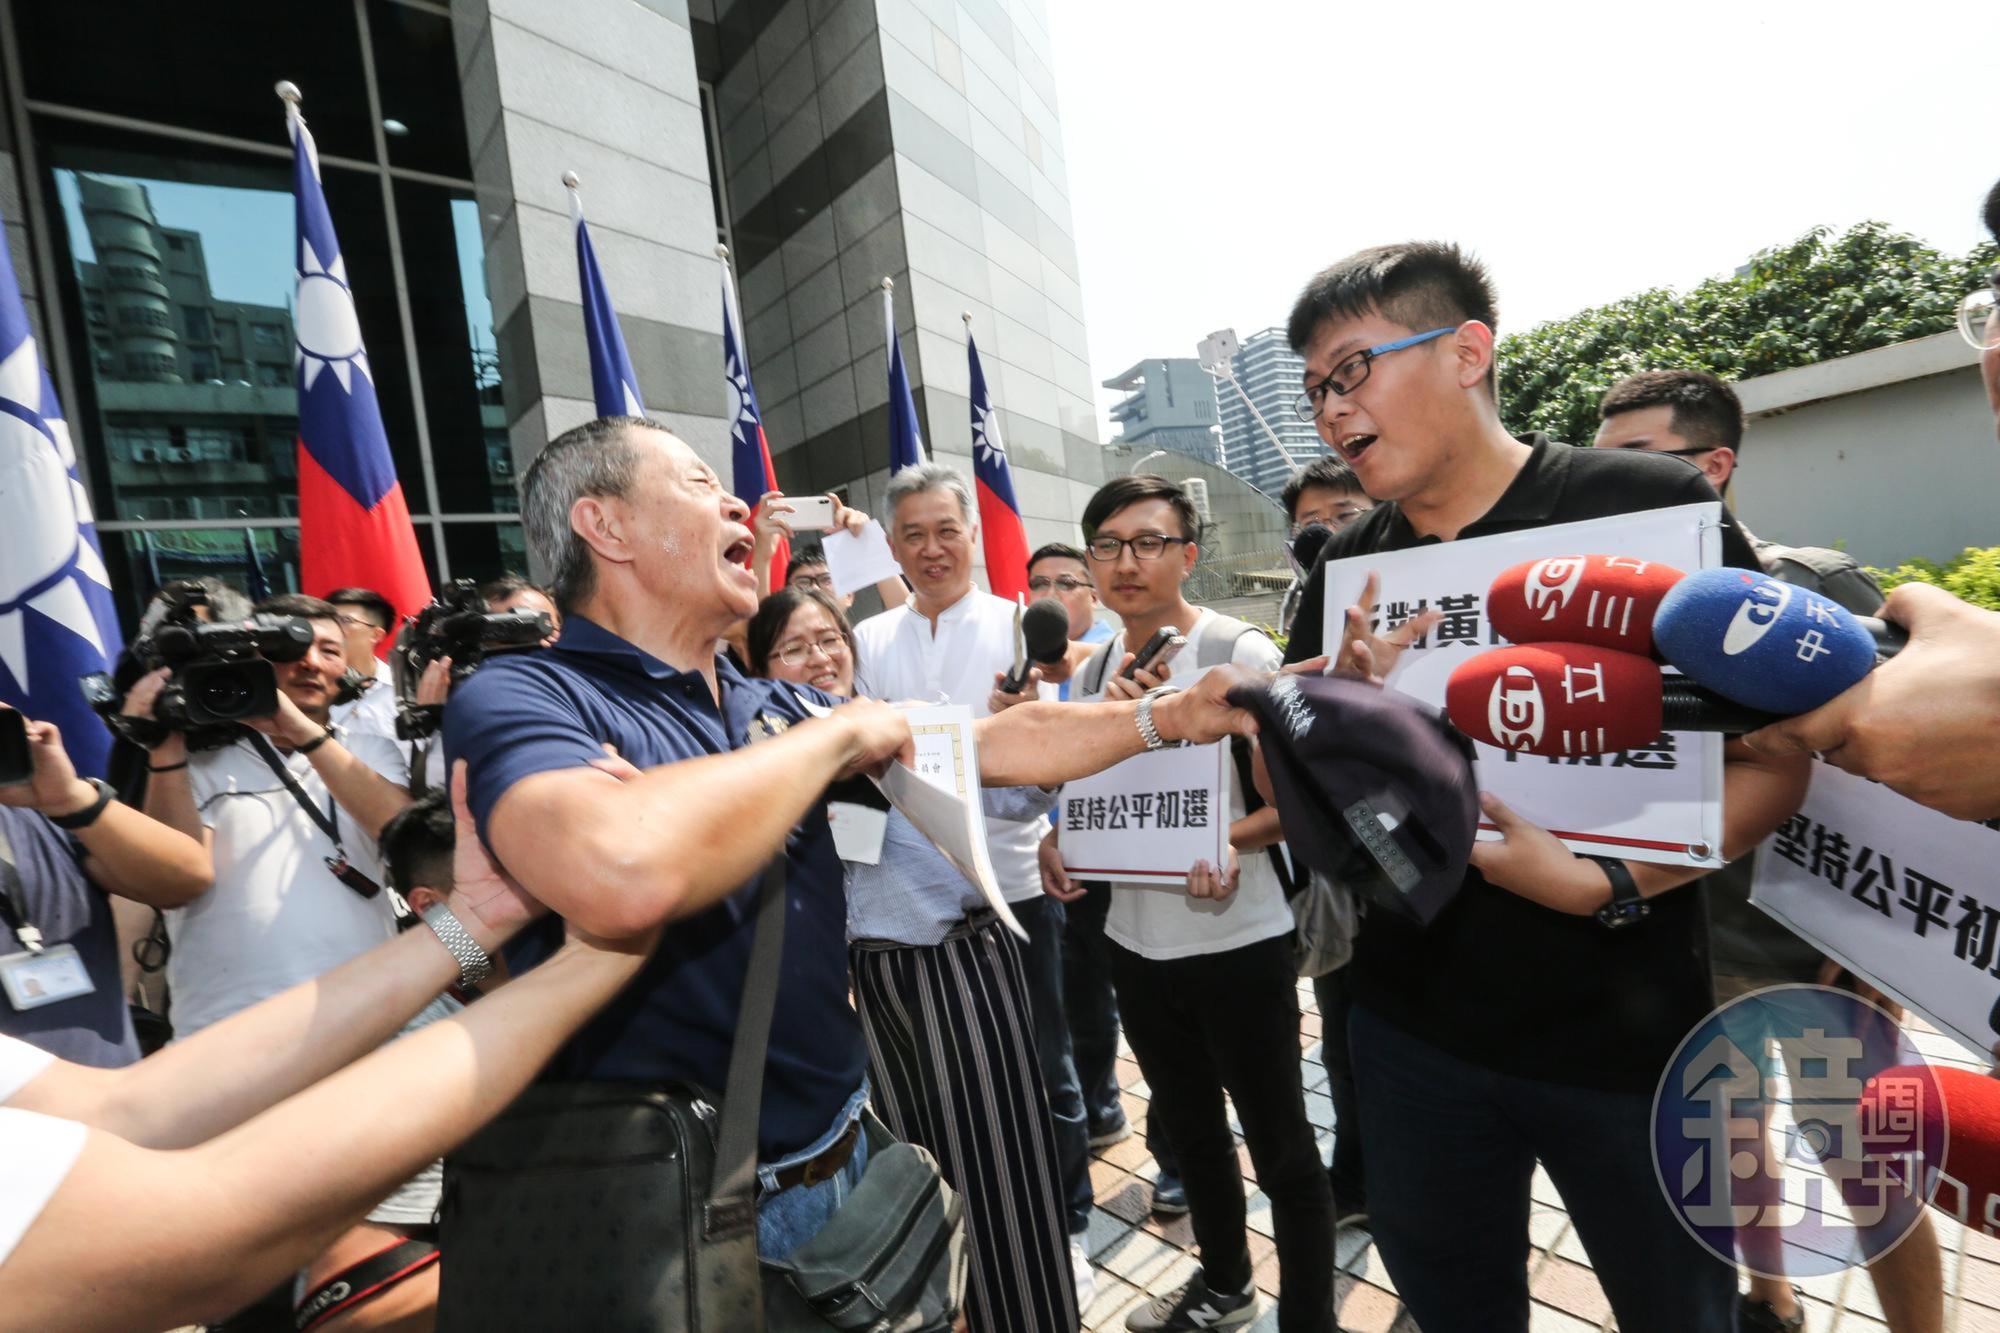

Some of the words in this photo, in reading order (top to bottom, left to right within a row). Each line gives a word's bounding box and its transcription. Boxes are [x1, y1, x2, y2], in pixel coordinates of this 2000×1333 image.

[1796, 597, 1841, 662] 中天
[1561, 662, 1605, 754] 三立
[1067, 788, 1208, 831] 堅持公平初選
[1186, 1302, 1224, 1329] N
